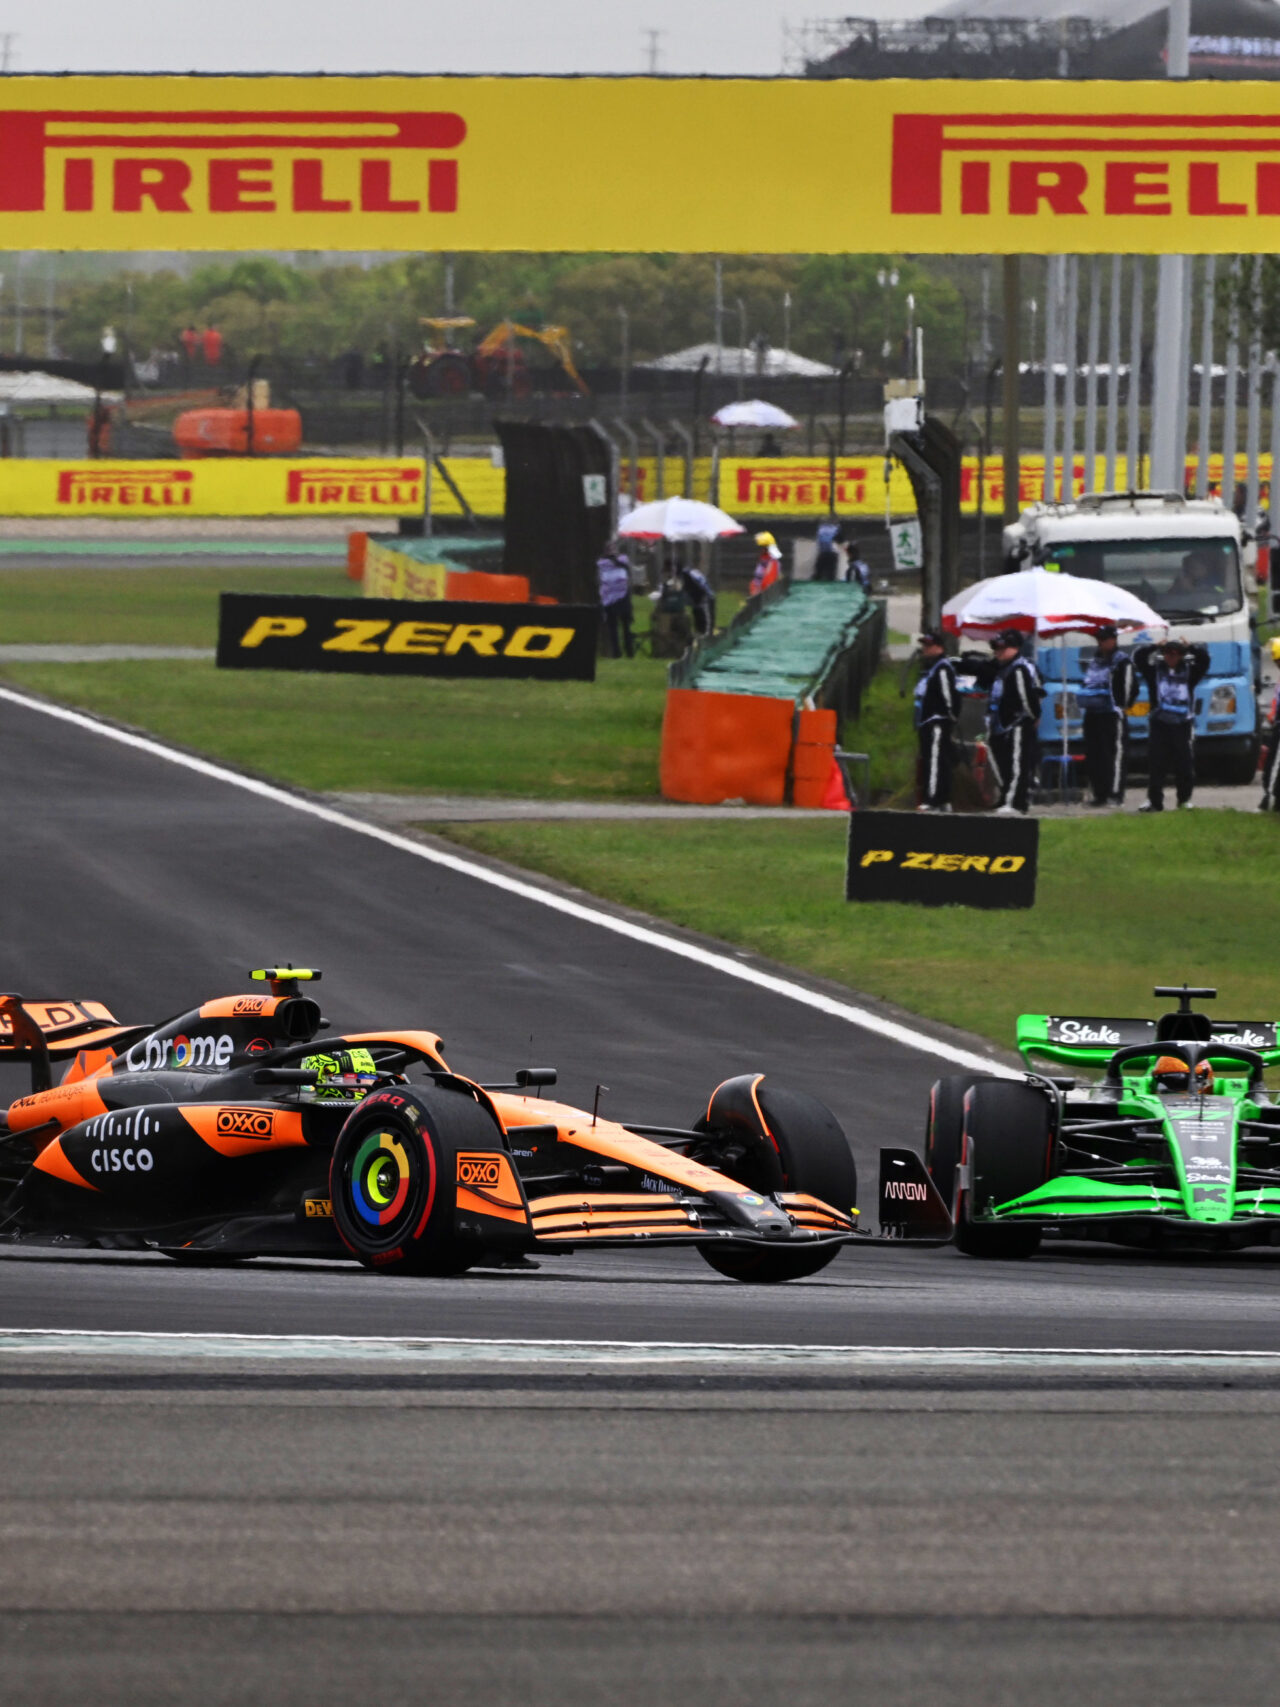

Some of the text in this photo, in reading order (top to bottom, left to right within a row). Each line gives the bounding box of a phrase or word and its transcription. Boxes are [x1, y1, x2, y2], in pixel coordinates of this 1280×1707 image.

[891, 113, 1280, 216] PIREL
[58, 469, 194, 506] PIRELLI
[286, 468, 422, 505] PIRELLI
[737, 467, 867, 504] PIRELLI
[240, 616, 576, 658] P ZERO
[860, 850, 1026, 874] P ZERO
[234, 999, 262, 1011] OXXO
[1060, 1020, 1120, 1044] Stake
[126, 1032, 235, 1072] Chrome
[218, 1112, 272, 1135] OXXO
[91, 1148, 154, 1172] CISCO
[460, 1162, 500, 1183] OXXO
